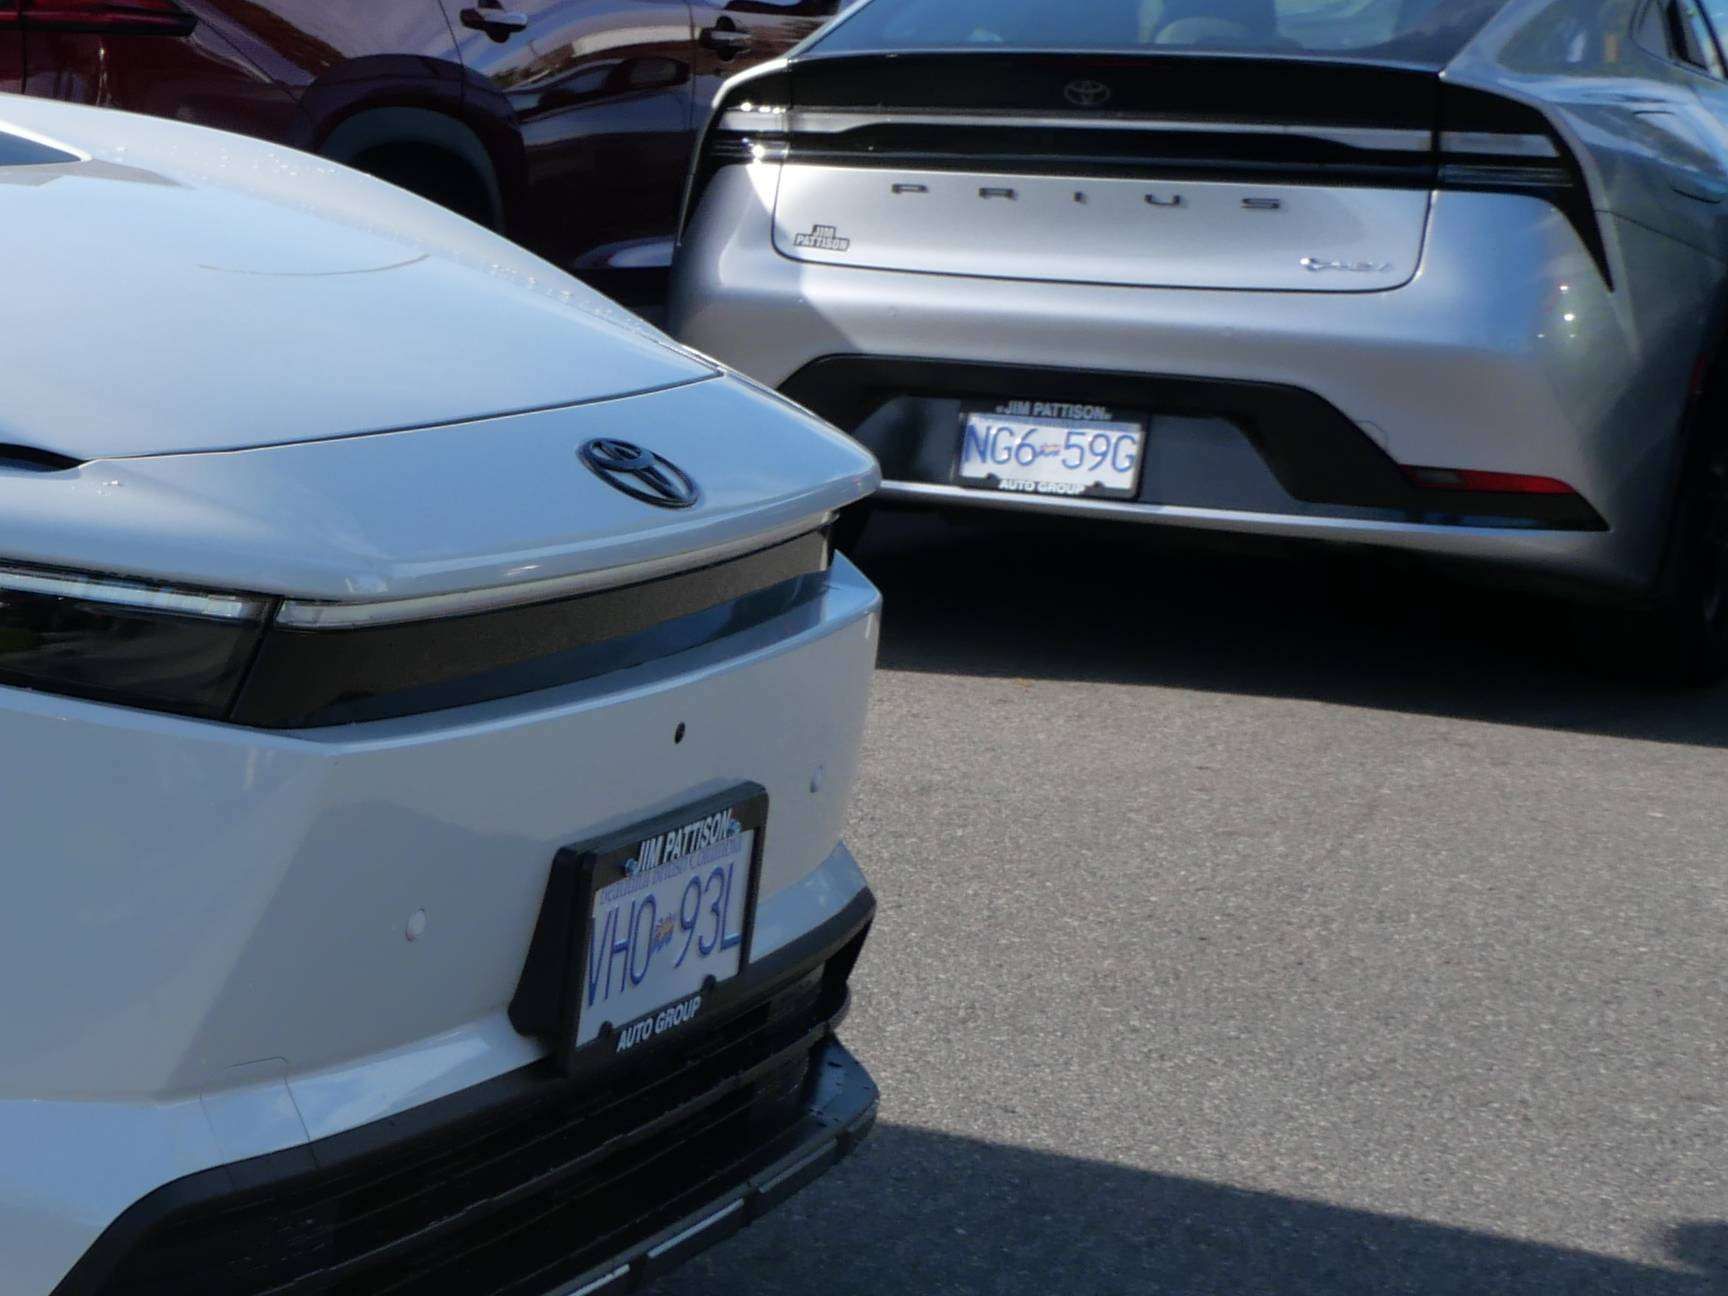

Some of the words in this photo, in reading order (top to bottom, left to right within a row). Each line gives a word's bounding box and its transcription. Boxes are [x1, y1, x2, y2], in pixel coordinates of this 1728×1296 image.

[891, 183, 1281, 210] PRIUS
[1005, 401, 1030, 412] JIM
[1034, 402, 1105, 421] PATTISON
[963, 423, 1039, 467] NG6
[1061, 430, 1137, 473] 59G
[998, 478, 1035, 491] AUTO
[1037, 481, 1086, 495] GROUP
[638, 836, 664, 872] JIM
[666, 809, 733, 862] PATTISON
[674, 862, 742, 970] 93L
[616, 1020, 653, 1054] AUTO
[654, 996, 702, 1035] GROUP
